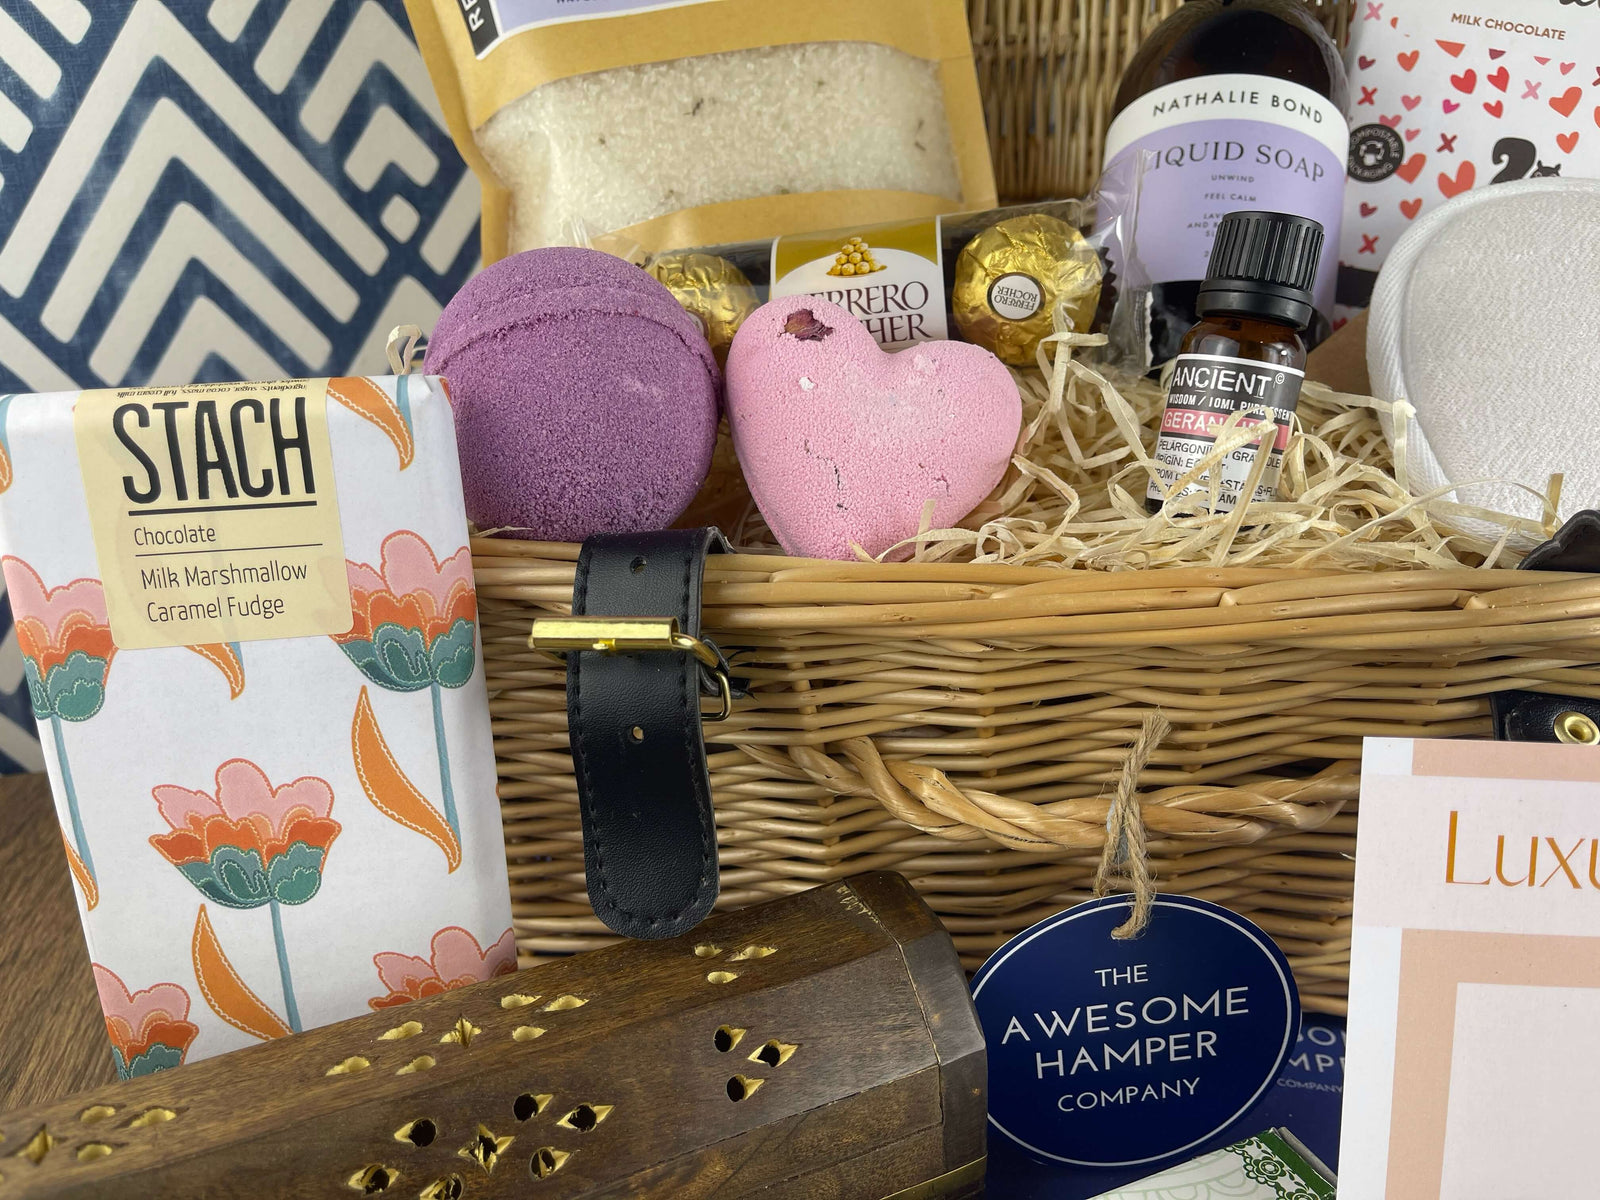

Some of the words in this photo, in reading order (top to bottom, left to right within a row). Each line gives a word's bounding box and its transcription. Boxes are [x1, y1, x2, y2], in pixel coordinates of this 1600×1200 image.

[1450, 12, 1482, 27] MILK
[1484, 18, 1567, 40] CHOCOLATE
[1152, 90, 1260, 117] NATHALIE
[1271, 94, 1323, 123] BOND
[1152, 141, 1245, 169] IQUID
[1256, 144, 1325, 182] SOAP
[1211, 174, 1255, 183] UNWIND
[1230, 194, 1256, 202] CALM
[801, 281, 929, 316] RRERO
[994, 294, 1036, 311] FERRERO
[997, 285, 1038, 303] ROCHER
[1169, 393, 1196, 406] WISDOM
[1208, 396, 1236, 411] 10ML
[112, 396, 316, 505] STACH
[133, 524, 217, 547] Chocolate
[141, 566, 181, 590] Milk
[184, 560, 308, 588] Marshmallow
[147, 597, 222, 623] Caramel
[227, 594, 286, 619] Fudge
[1094, 963, 1149, 987] THE
[1001, 986, 1250, 1045] AWESOME
[1036, 1030, 1218, 1079] HAMPER
[1057, 1077, 1201, 1112] COMPANY
